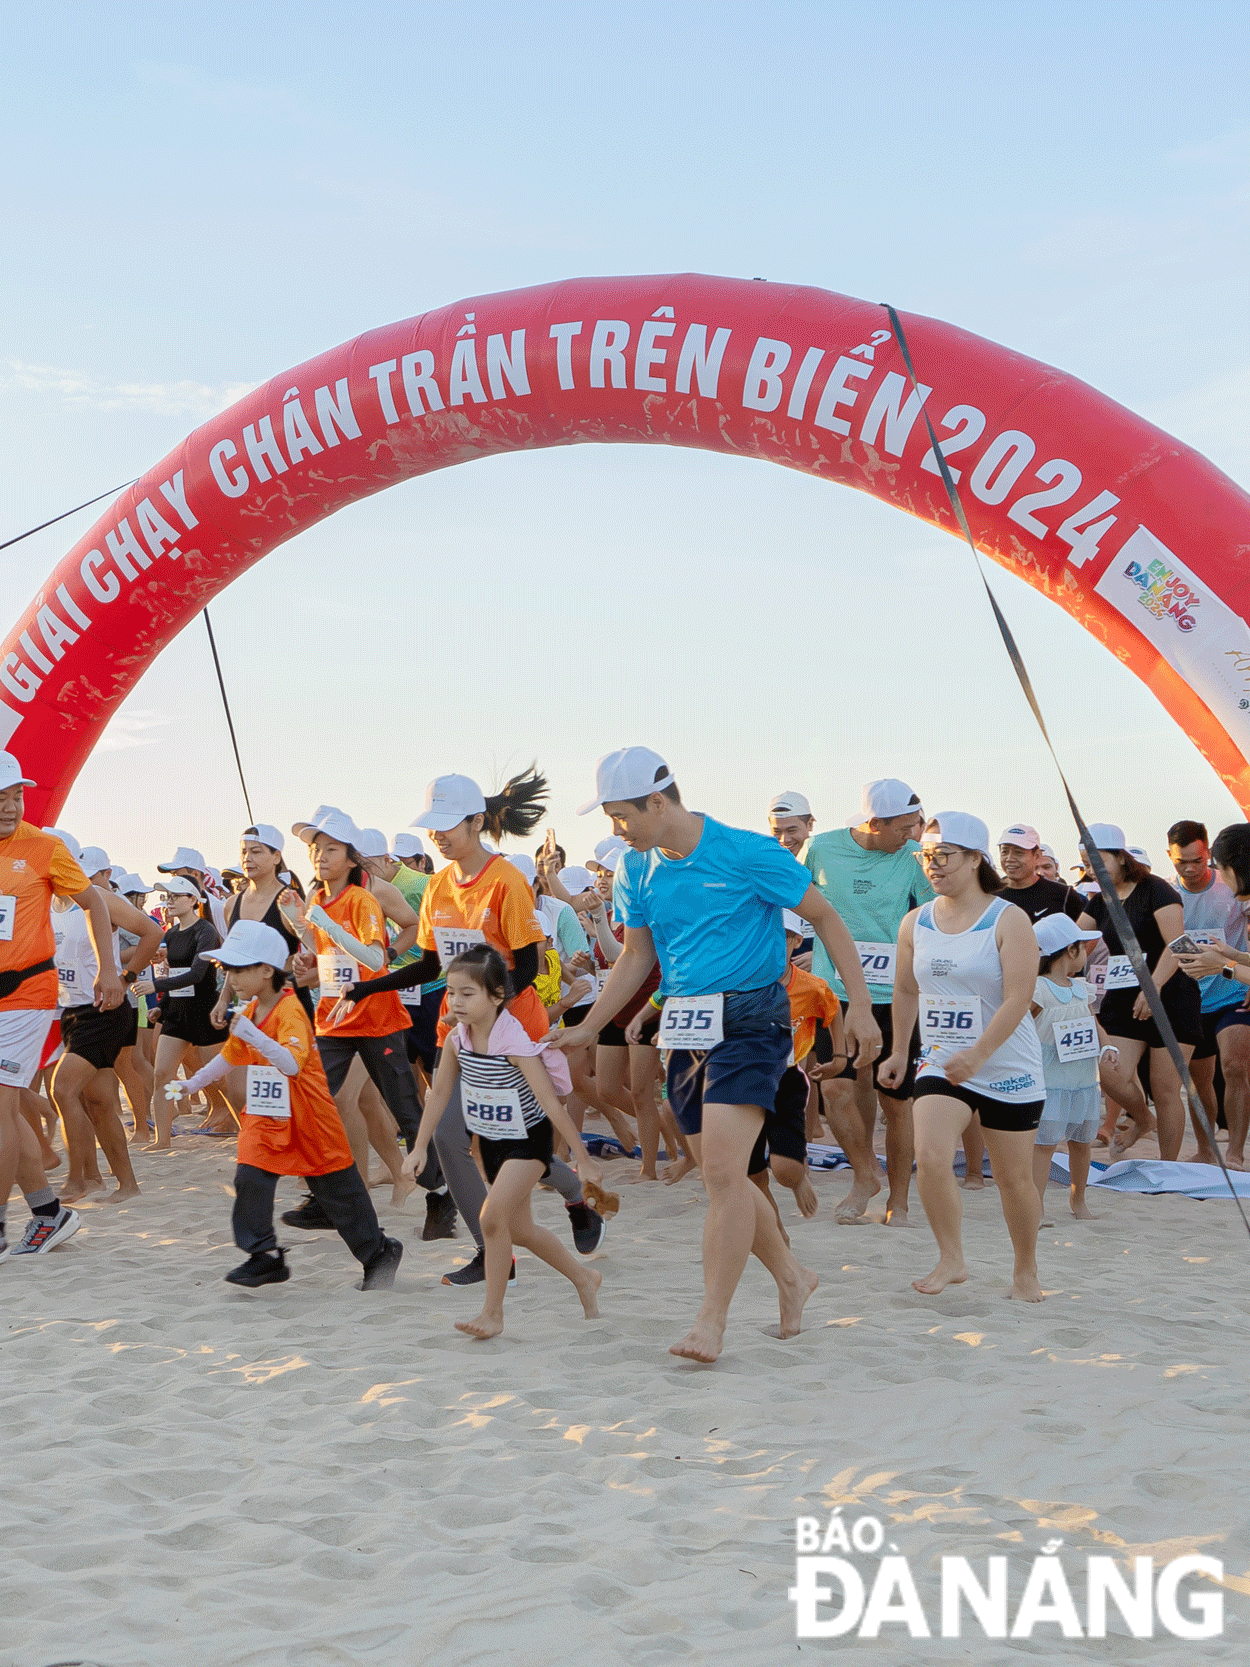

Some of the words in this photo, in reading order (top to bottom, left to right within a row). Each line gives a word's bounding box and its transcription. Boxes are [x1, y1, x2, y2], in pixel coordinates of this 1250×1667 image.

[79, 469, 201, 603] CHẠY
[208, 378, 362, 500] CHÂN
[369, 311, 531, 425] TRẦN
[549, 306, 731, 400] TRÊN
[742, 329, 934, 453] BIỂN
[920, 404, 1121, 569] 2024
[1147, 558, 1200, 606] ENJOY
[665, 1010, 714, 1030] 535
[926, 1010, 973, 1029] 536
[1060, 1029, 1094, 1047] 453
[251, 1081, 282, 1098] 336
[467, 1099, 513, 1122] 288
